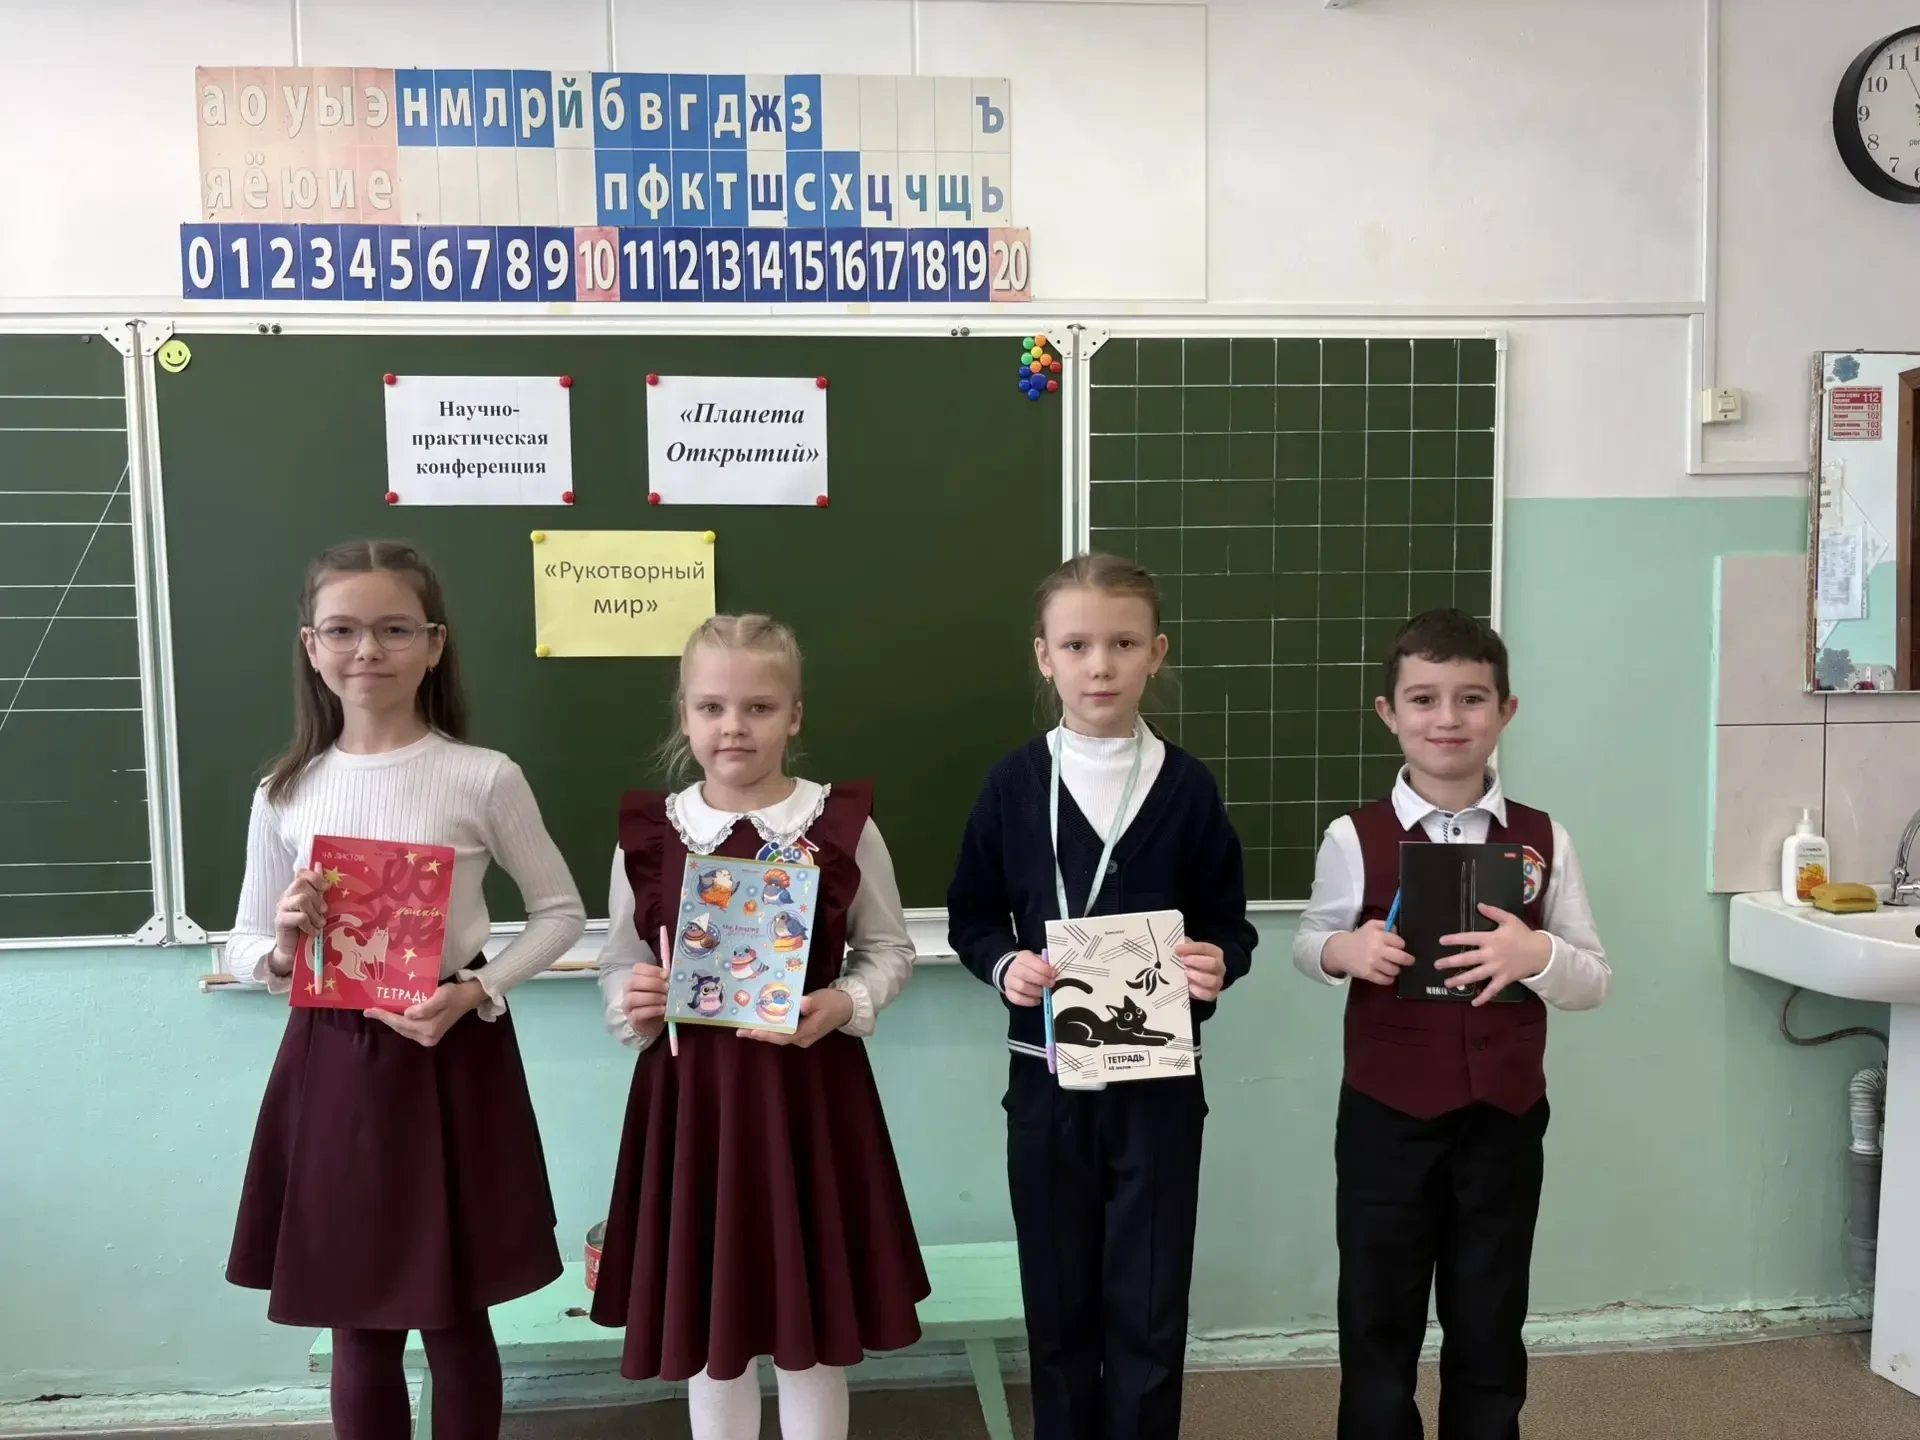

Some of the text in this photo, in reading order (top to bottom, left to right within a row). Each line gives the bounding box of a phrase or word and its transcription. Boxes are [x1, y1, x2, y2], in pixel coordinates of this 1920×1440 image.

[1886, 54, 1905, 70] 11
[1913, 46, 1920, 62] 1
[1867, 76, 1887, 92] 10
[202, 77, 1004, 138] а о у ы э н м л р й б в г д ж з ъ
[1858, 106, 1870, 122] 9
[1867, 134, 1879, 150] 8
[1889, 157, 1899, 173] 7
[207, 152, 1004, 220] я ё ю и е п ф к т ш с х ц ч щ ь
[188, 237, 1028, 291] 0 1 2 3 4 5 6 7 8 9 10 11 12 13 14 15 16 17 18 19 20
[1863, 392, 1879, 402] 112
[439, 401, 520, 420] Научно-
[680, 402, 804, 424] «Планета
[412, 430, 548, 449] практическая
[666, 441, 818, 466] Открытий»
[416, 457, 546, 479] конференция
[545, 561, 705, 582] «Рукотворный
[594, 596, 658, 617] мир»
[783, 847, 801, 860] 60
[376, 986, 428, 1004] ТЕТРАДЬ
[1107, 1054, 1145, 1064] ТЕТРАДЬ
